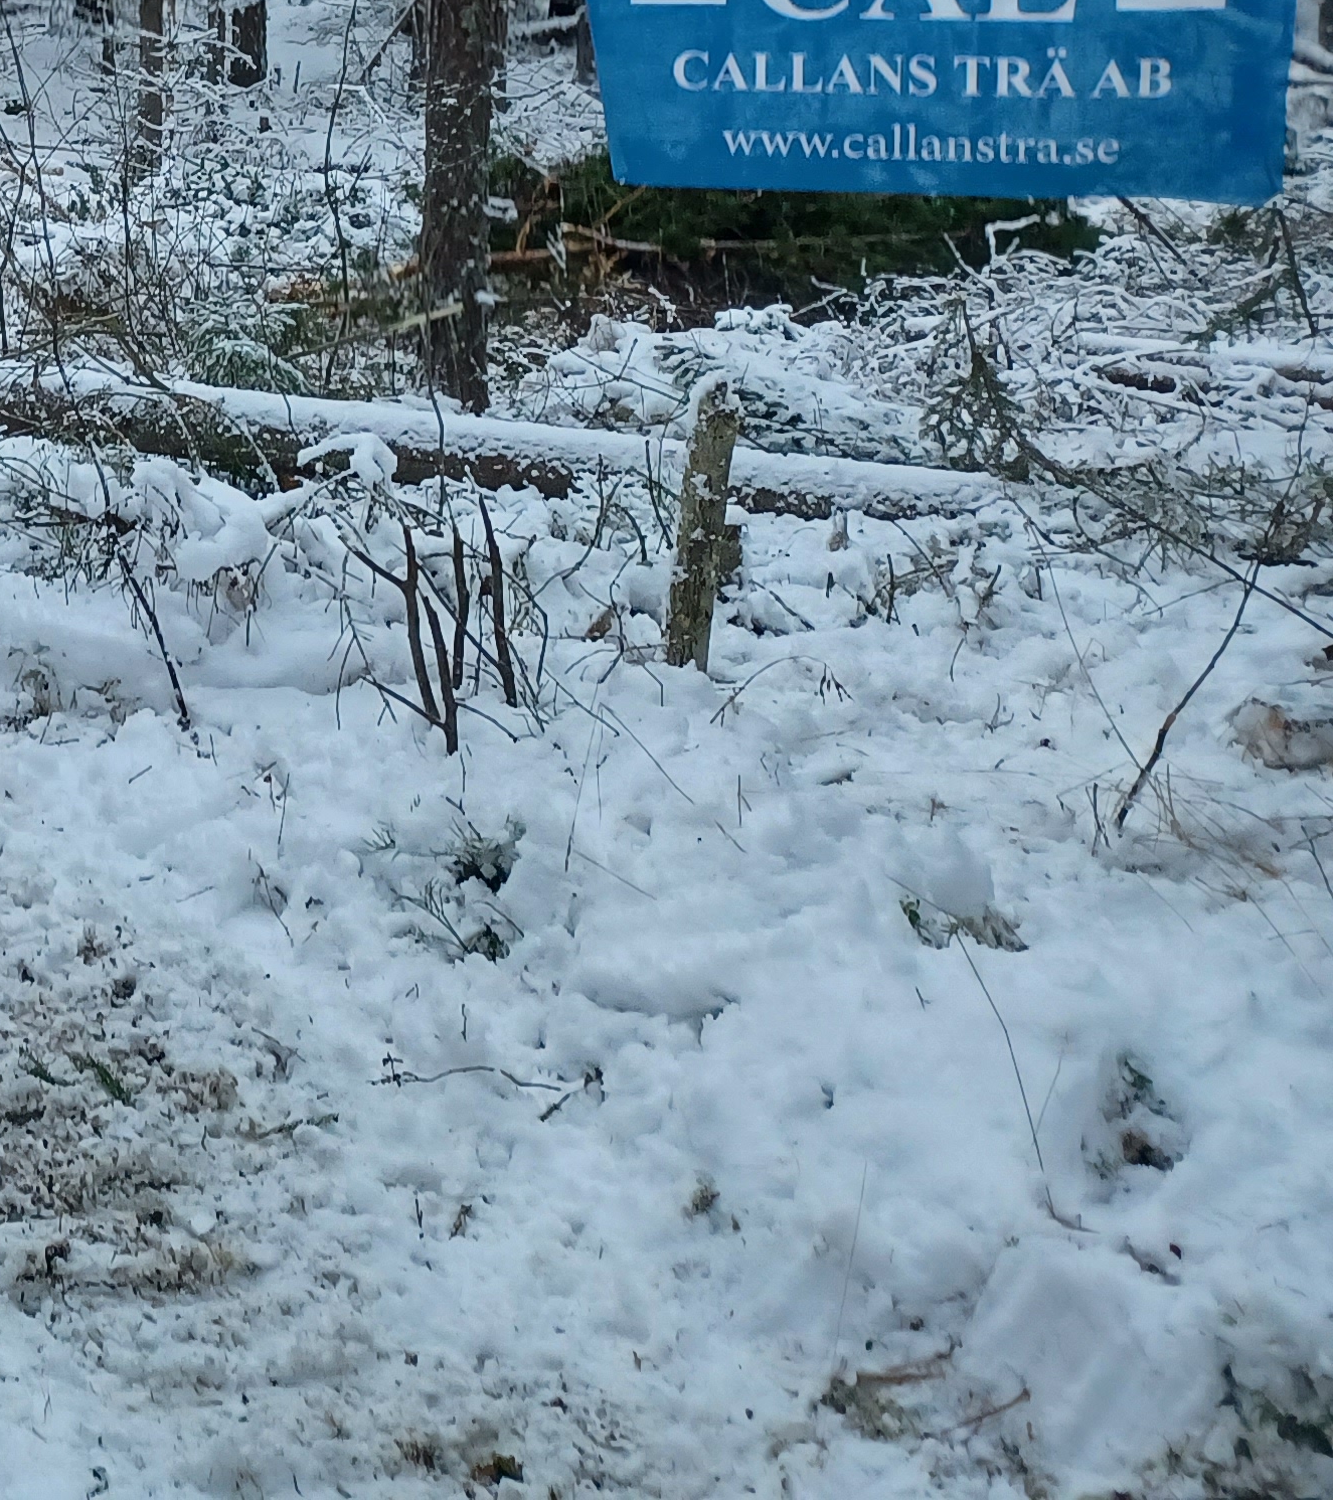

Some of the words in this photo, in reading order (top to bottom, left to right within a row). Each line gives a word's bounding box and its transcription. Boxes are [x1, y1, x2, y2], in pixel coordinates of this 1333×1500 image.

[671, 48, 937, 96] CALLANS
[953, 46, 1075, 100] TRÄ
[1089, 56, 1173, 100] AB
[721, 122, 1121, 166] www.callanstra.se
